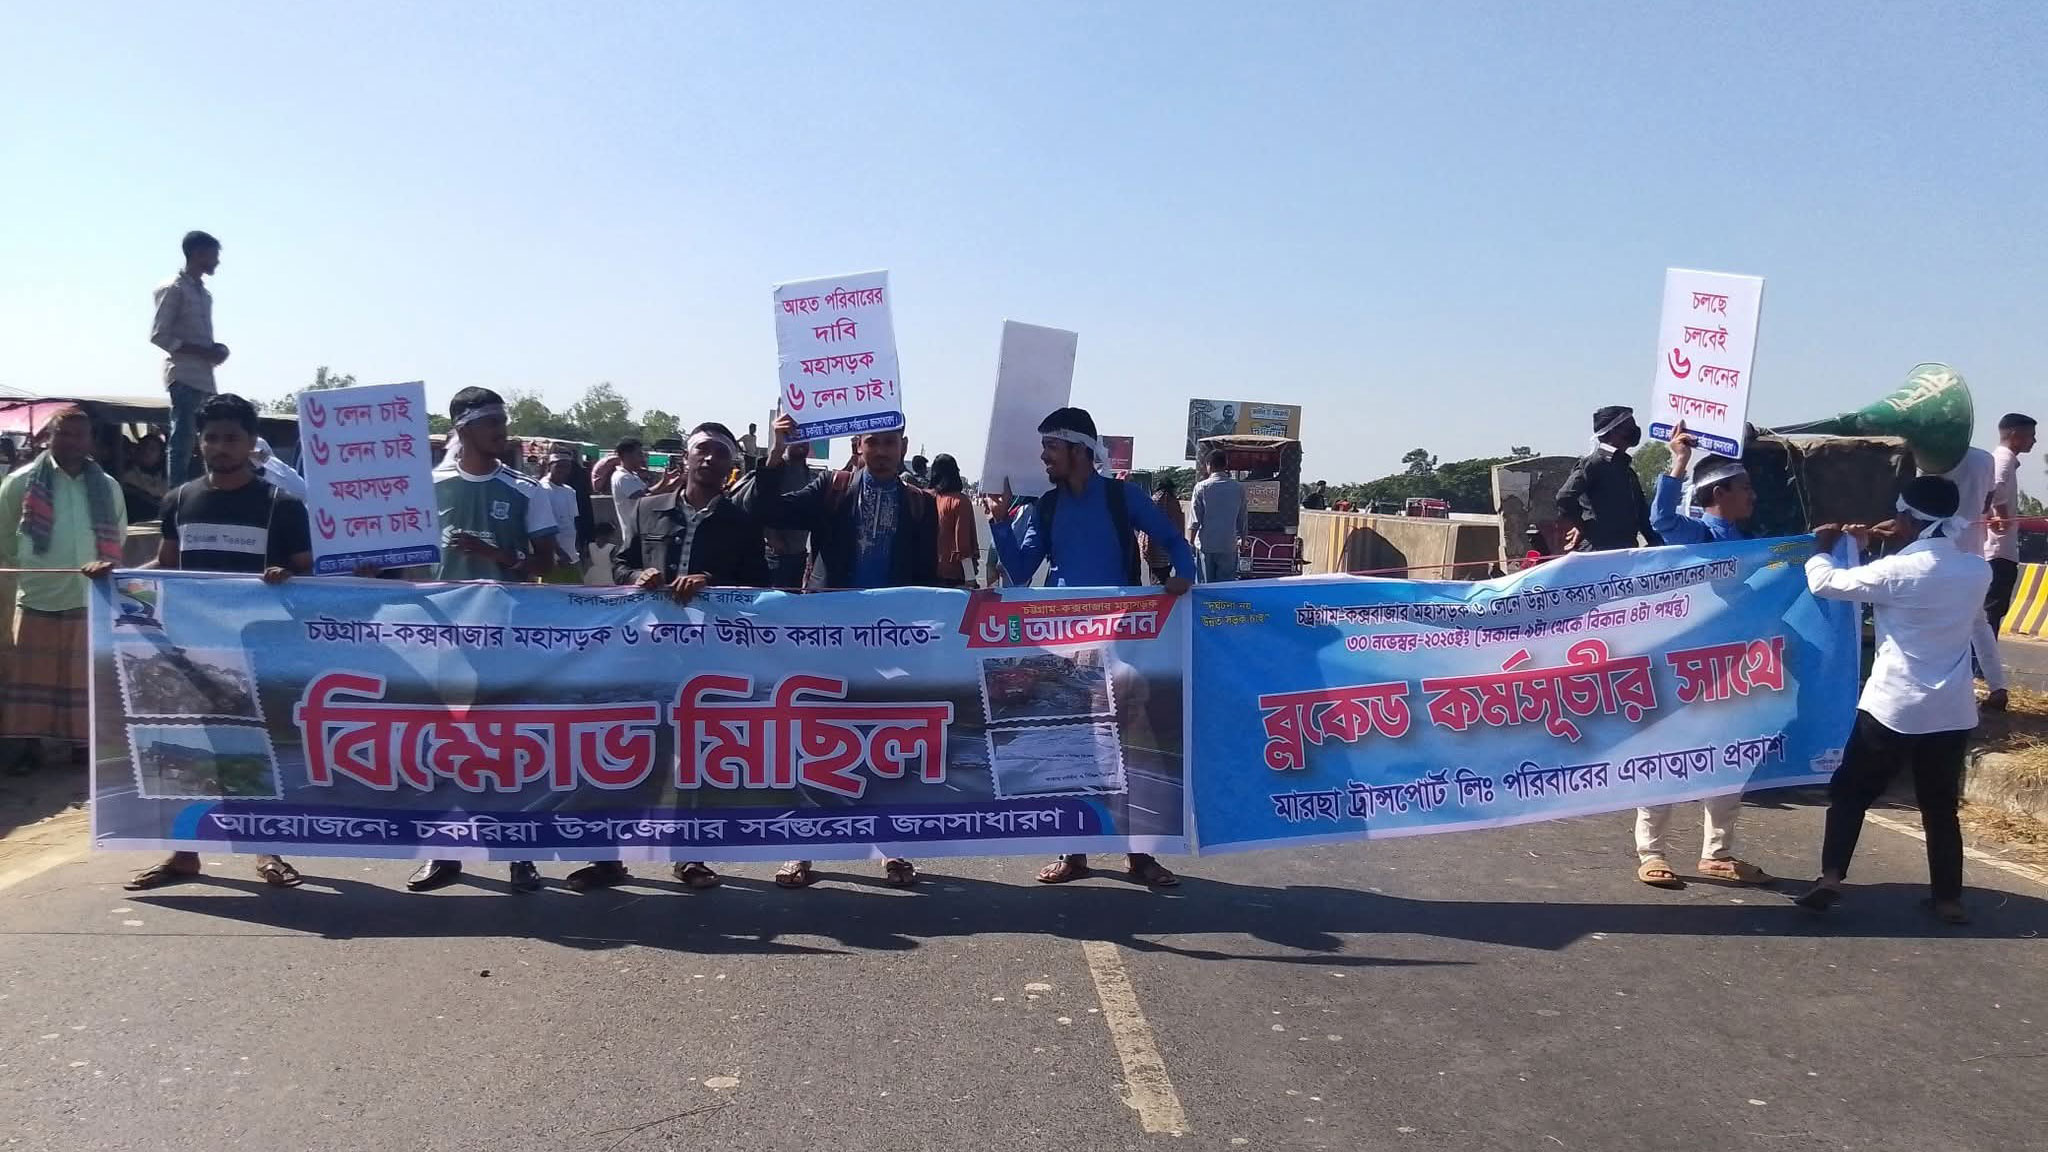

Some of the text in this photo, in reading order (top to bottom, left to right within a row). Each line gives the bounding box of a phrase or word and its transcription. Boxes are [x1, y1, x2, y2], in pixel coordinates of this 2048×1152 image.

[781, 286, 884, 316] আহত পরিবারের
[1692, 291, 1728, 317] চলছে
[812, 317, 858, 343] দাবি
[1683, 325, 1728, 352] চলবেই
[800, 351, 874, 376] মহাসড়ক
[1667, 347, 1740, 389] ৬ লেনের
[305, 396, 414, 428] ৬ লেন চাই
[786, 383, 805, 411] ৬
[812, 386, 848, 409] লেন
[1668, 393, 1729, 424] আন্দোলন
[308, 433, 416, 465] ৬ লেন চাই
[329, 475, 411, 501] মহাসড়ক
[315, 507, 336, 540] ৬
[344, 515, 384, 538] লেন
[1413, 600, 1469, 624] মহাসড়ক
[1473, 603, 1486, 618] ৬
[1489, 594, 1521, 617] লেনে
[1521, 586, 1561, 613] উন্নীত
[1562, 583, 1597, 604] করার
[1598, 573, 1635, 600] দাবির
[1636, 563, 1707, 592] আন্দোলনের
[1708, 555, 1739, 578] সাথে
[303, 614, 505, 650] চট্টগ্রাম-কক্সবাজার
[511, 624, 614, 651] মহাসড়ক
[621, 626, 639, 646] ৬
[648, 622, 706, 647] লেনে
[713, 616, 778, 648] উন্নীত
[783, 623, 844, 648] করার
[979, 615, 1006, 643] ৬
[1023, 611, 1158, 641] আন্দোলন
[1346, 635, 1368, 651] ৩০
[1550, 614, 1582, 636] থেকে
[1586, 605, 1626, 631] বিকাল
[1629, 603, 1651, 624] ৪টা
[1258, 635, 1785, 770] ব্লকেড কর্মসূচীর সাথে
[293, 670, 954, 799] বিক্ষোভ মিছিল
[1271, 786, 1342, 824] মারছা
[1346, 769, 1450, 820] ট্রান্সপোর্ট
[1501, 760, 1611, 800] পরিবারের
[1616, 744, 1718, 782] একাত্মতা
[1723, 731, 1789, 770] প্রকাশ
[411, 814, 544, 842] চকরিয়া
[552, 814, 728, 840] উপজেলার
[736, 810, 878, 839] সর্বস্তরের
